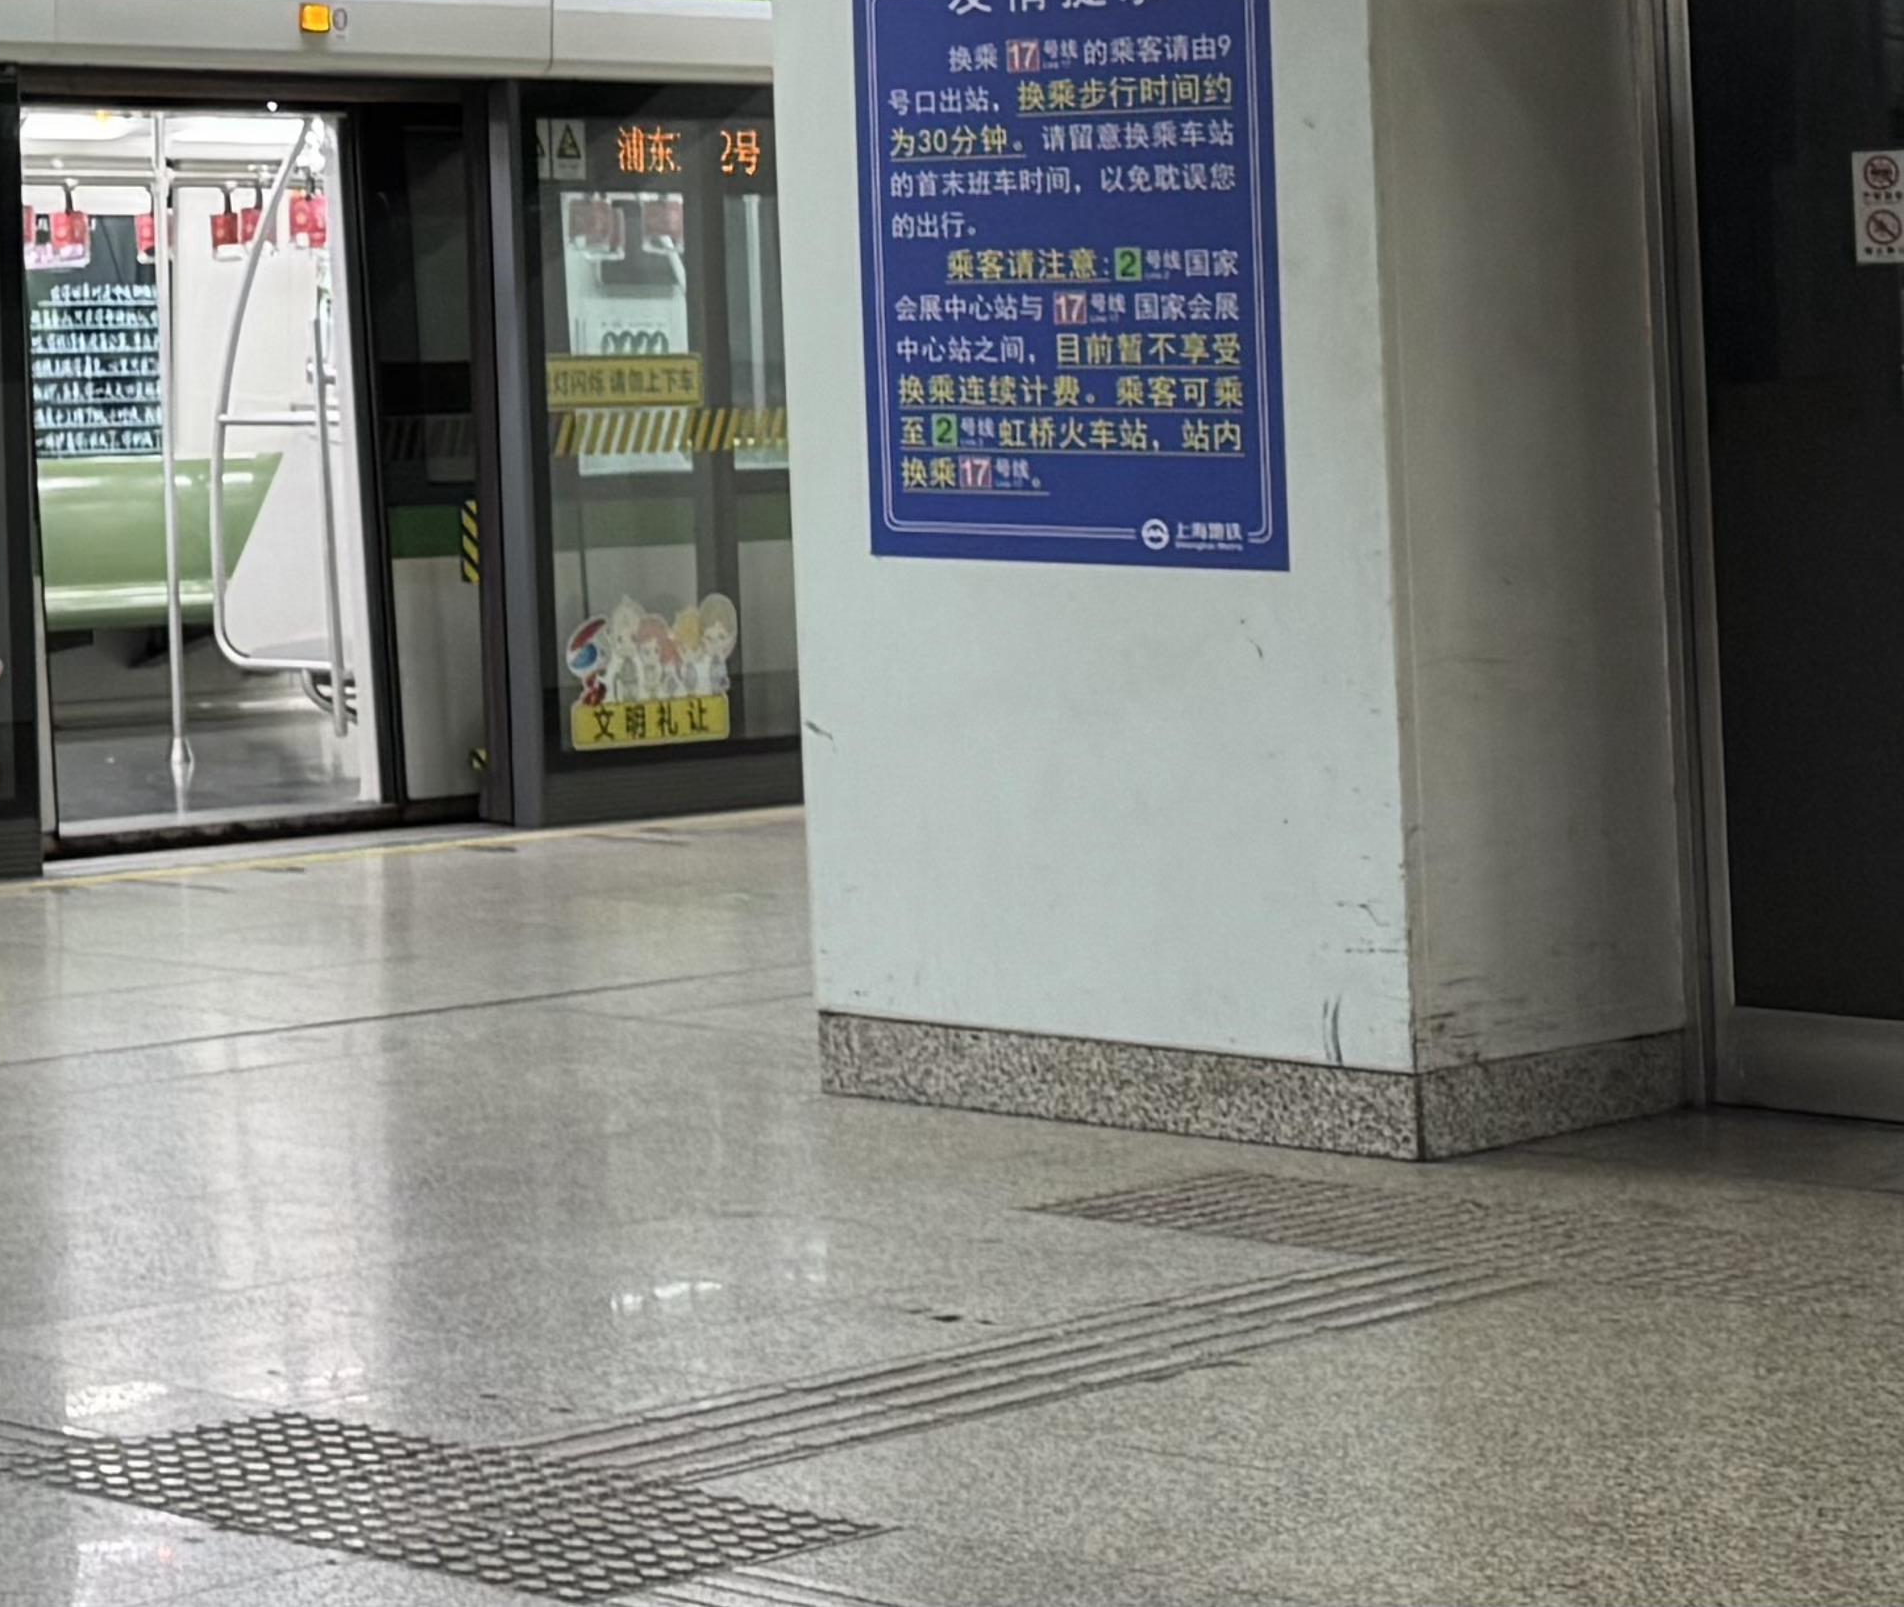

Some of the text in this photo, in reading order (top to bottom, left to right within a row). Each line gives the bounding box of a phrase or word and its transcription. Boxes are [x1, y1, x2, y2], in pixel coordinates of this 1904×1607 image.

[948, 44, 998, 74] 换乘
[616, 126, 682, 174] 浦东
[891, 212, 978, 240] 的出行。
[1183, 248, 1239, 278] 国家
[894, 293, 1043, 322] 会展中心站与
[1134, 292, 1240, 322] 国家会展
[901, 457, 958, 489] 换乘
[593, 698, 708, 742] 文明礼让
